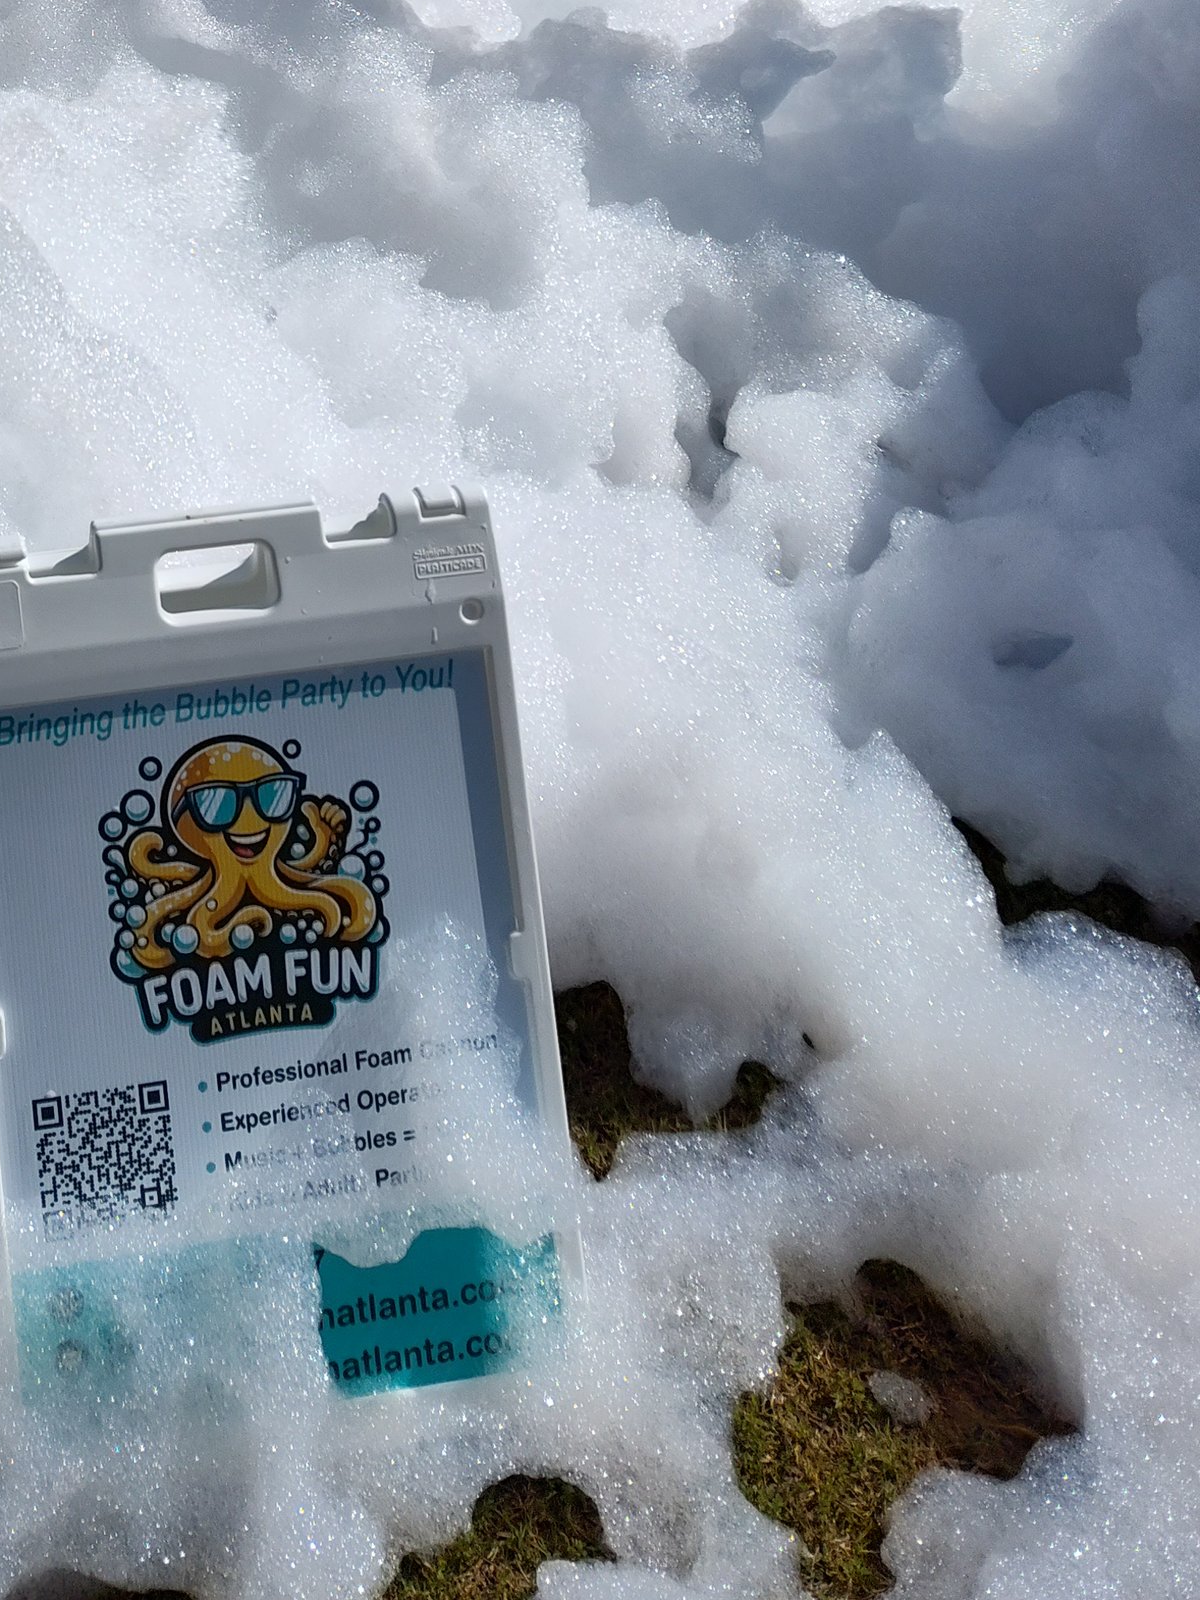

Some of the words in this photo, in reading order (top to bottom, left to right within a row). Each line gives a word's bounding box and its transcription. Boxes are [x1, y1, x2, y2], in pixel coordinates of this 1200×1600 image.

[123, 700, 166, 730] the
[175, 684, 272, 723] Bubble
[282, 675, 353, 710] Party
[361, 672, 386, 698] to
[396, 658, 453, 693] You!
[143, 952, 273, 1025] FOAM
[284, 947, 371, 996] FUN
[211, 1002, 313, 1036] ATLANTA
[216, 1052, 348, 1092] Professional
[355, 1047, 412, 1071] Foam
[419, 1033, 497, 1060] Canon
[220, 1093, 350, 1133] Experienced
